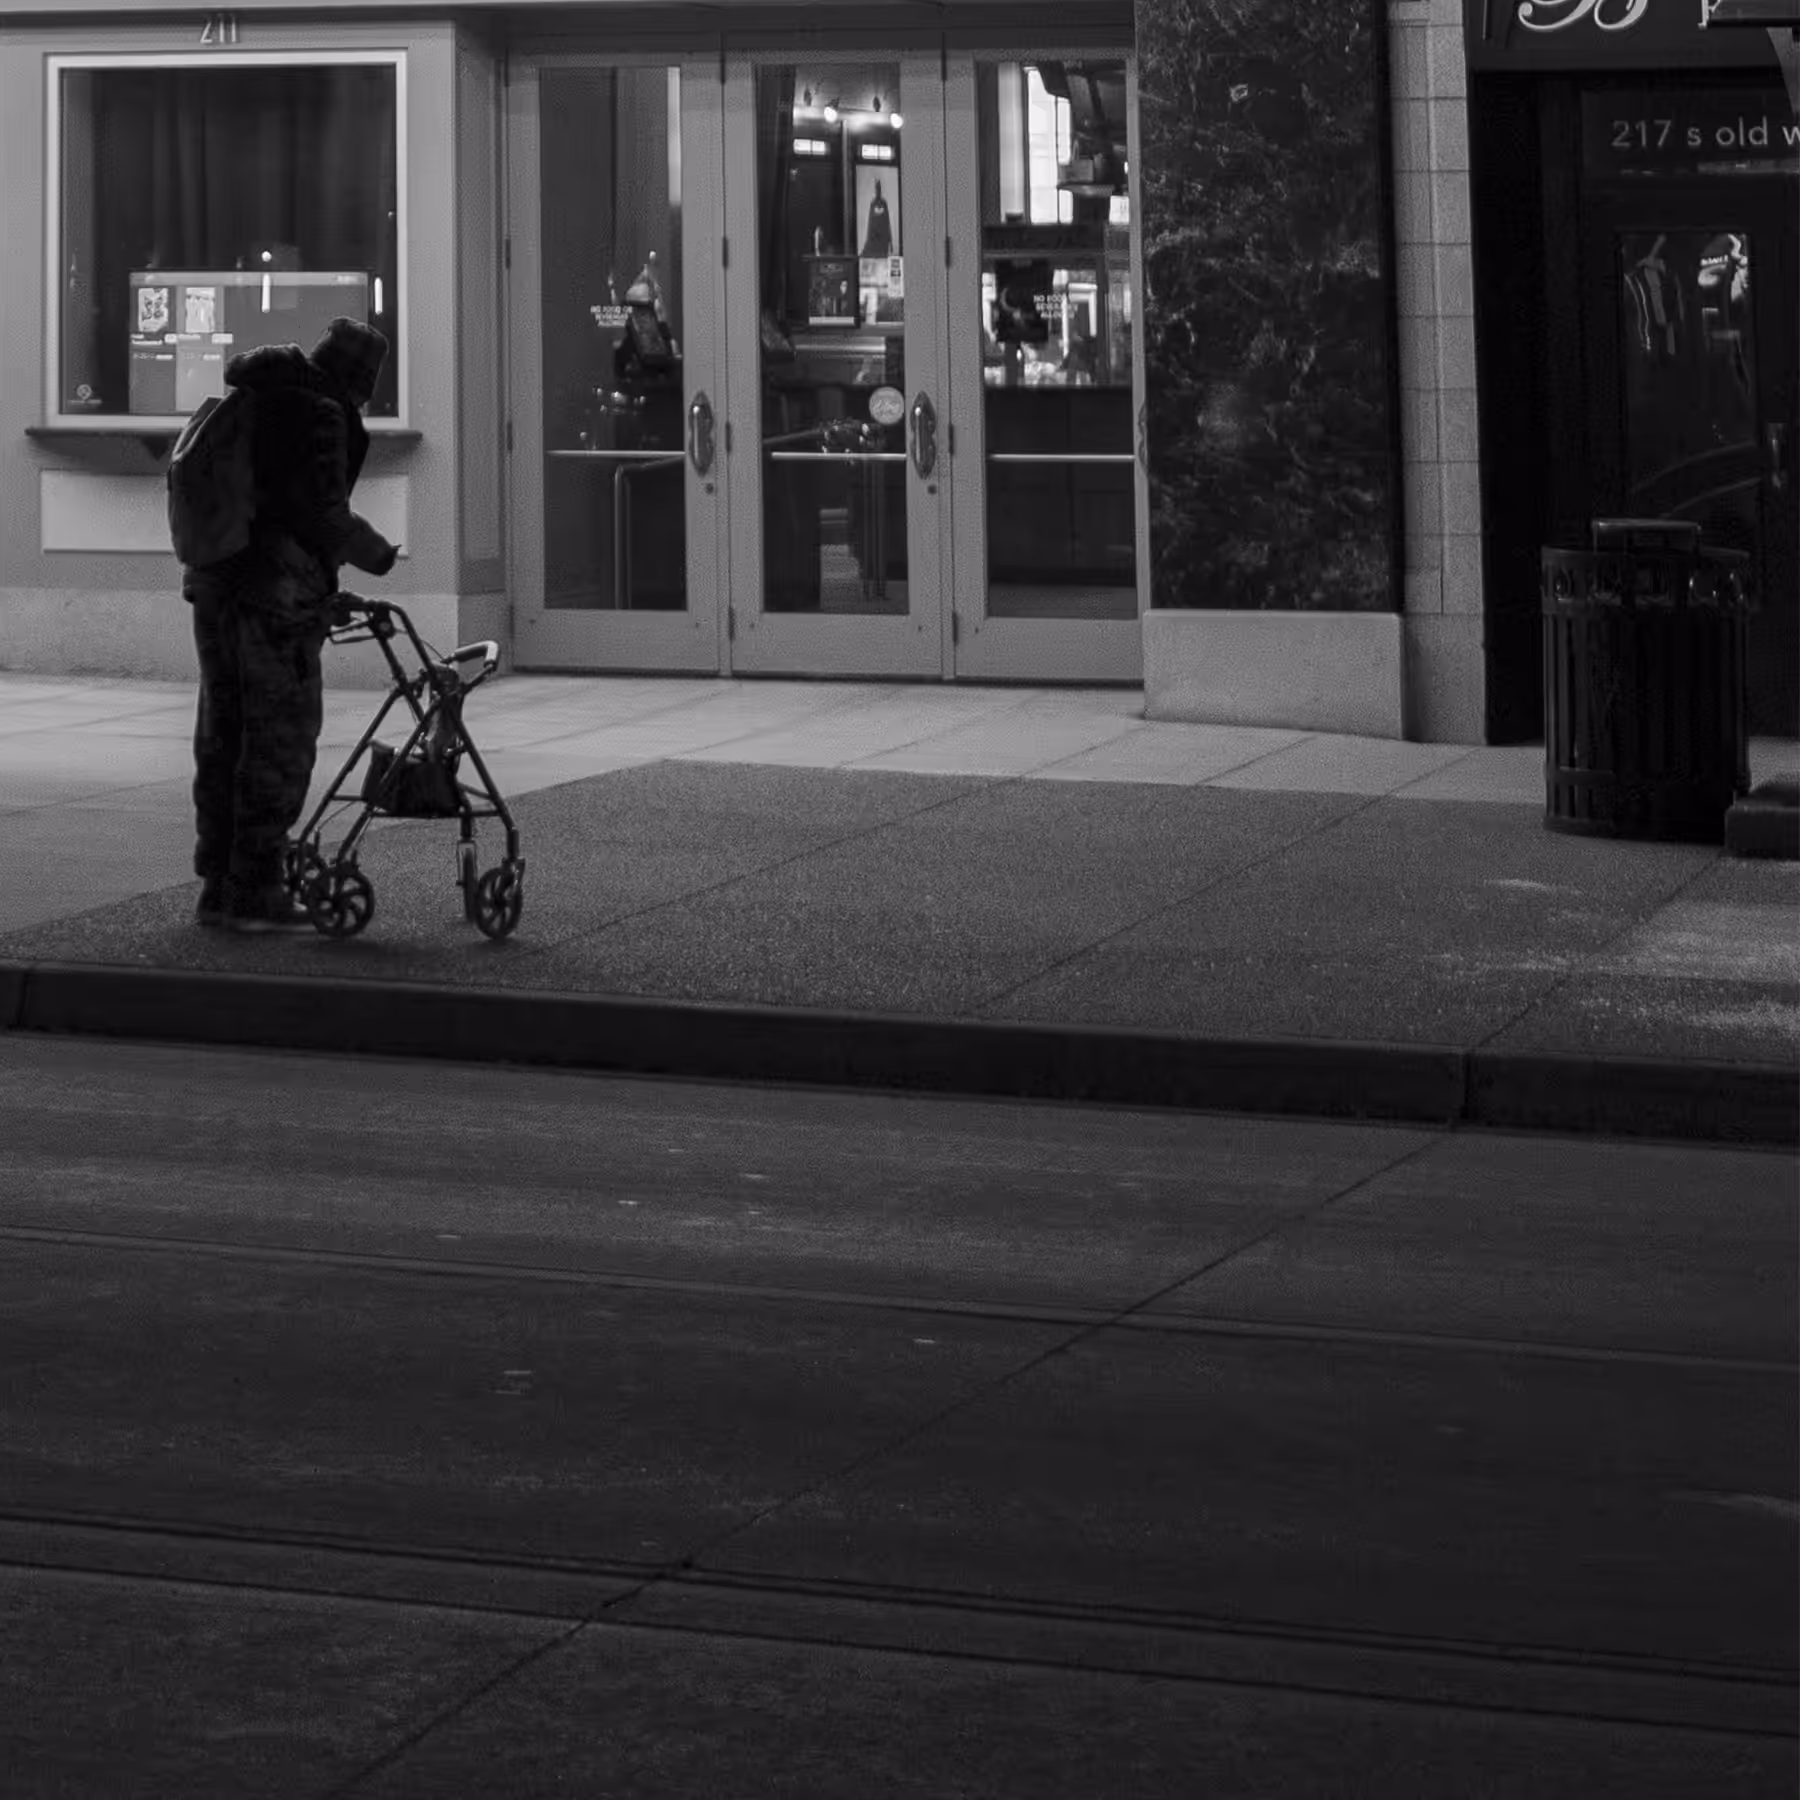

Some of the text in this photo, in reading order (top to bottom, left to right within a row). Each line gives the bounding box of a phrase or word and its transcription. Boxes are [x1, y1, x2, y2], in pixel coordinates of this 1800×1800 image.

[1611, 119, 1672, 148] 217
[1687, 126, 1702, 147] s
[1715, 114, 1769, 147] old
